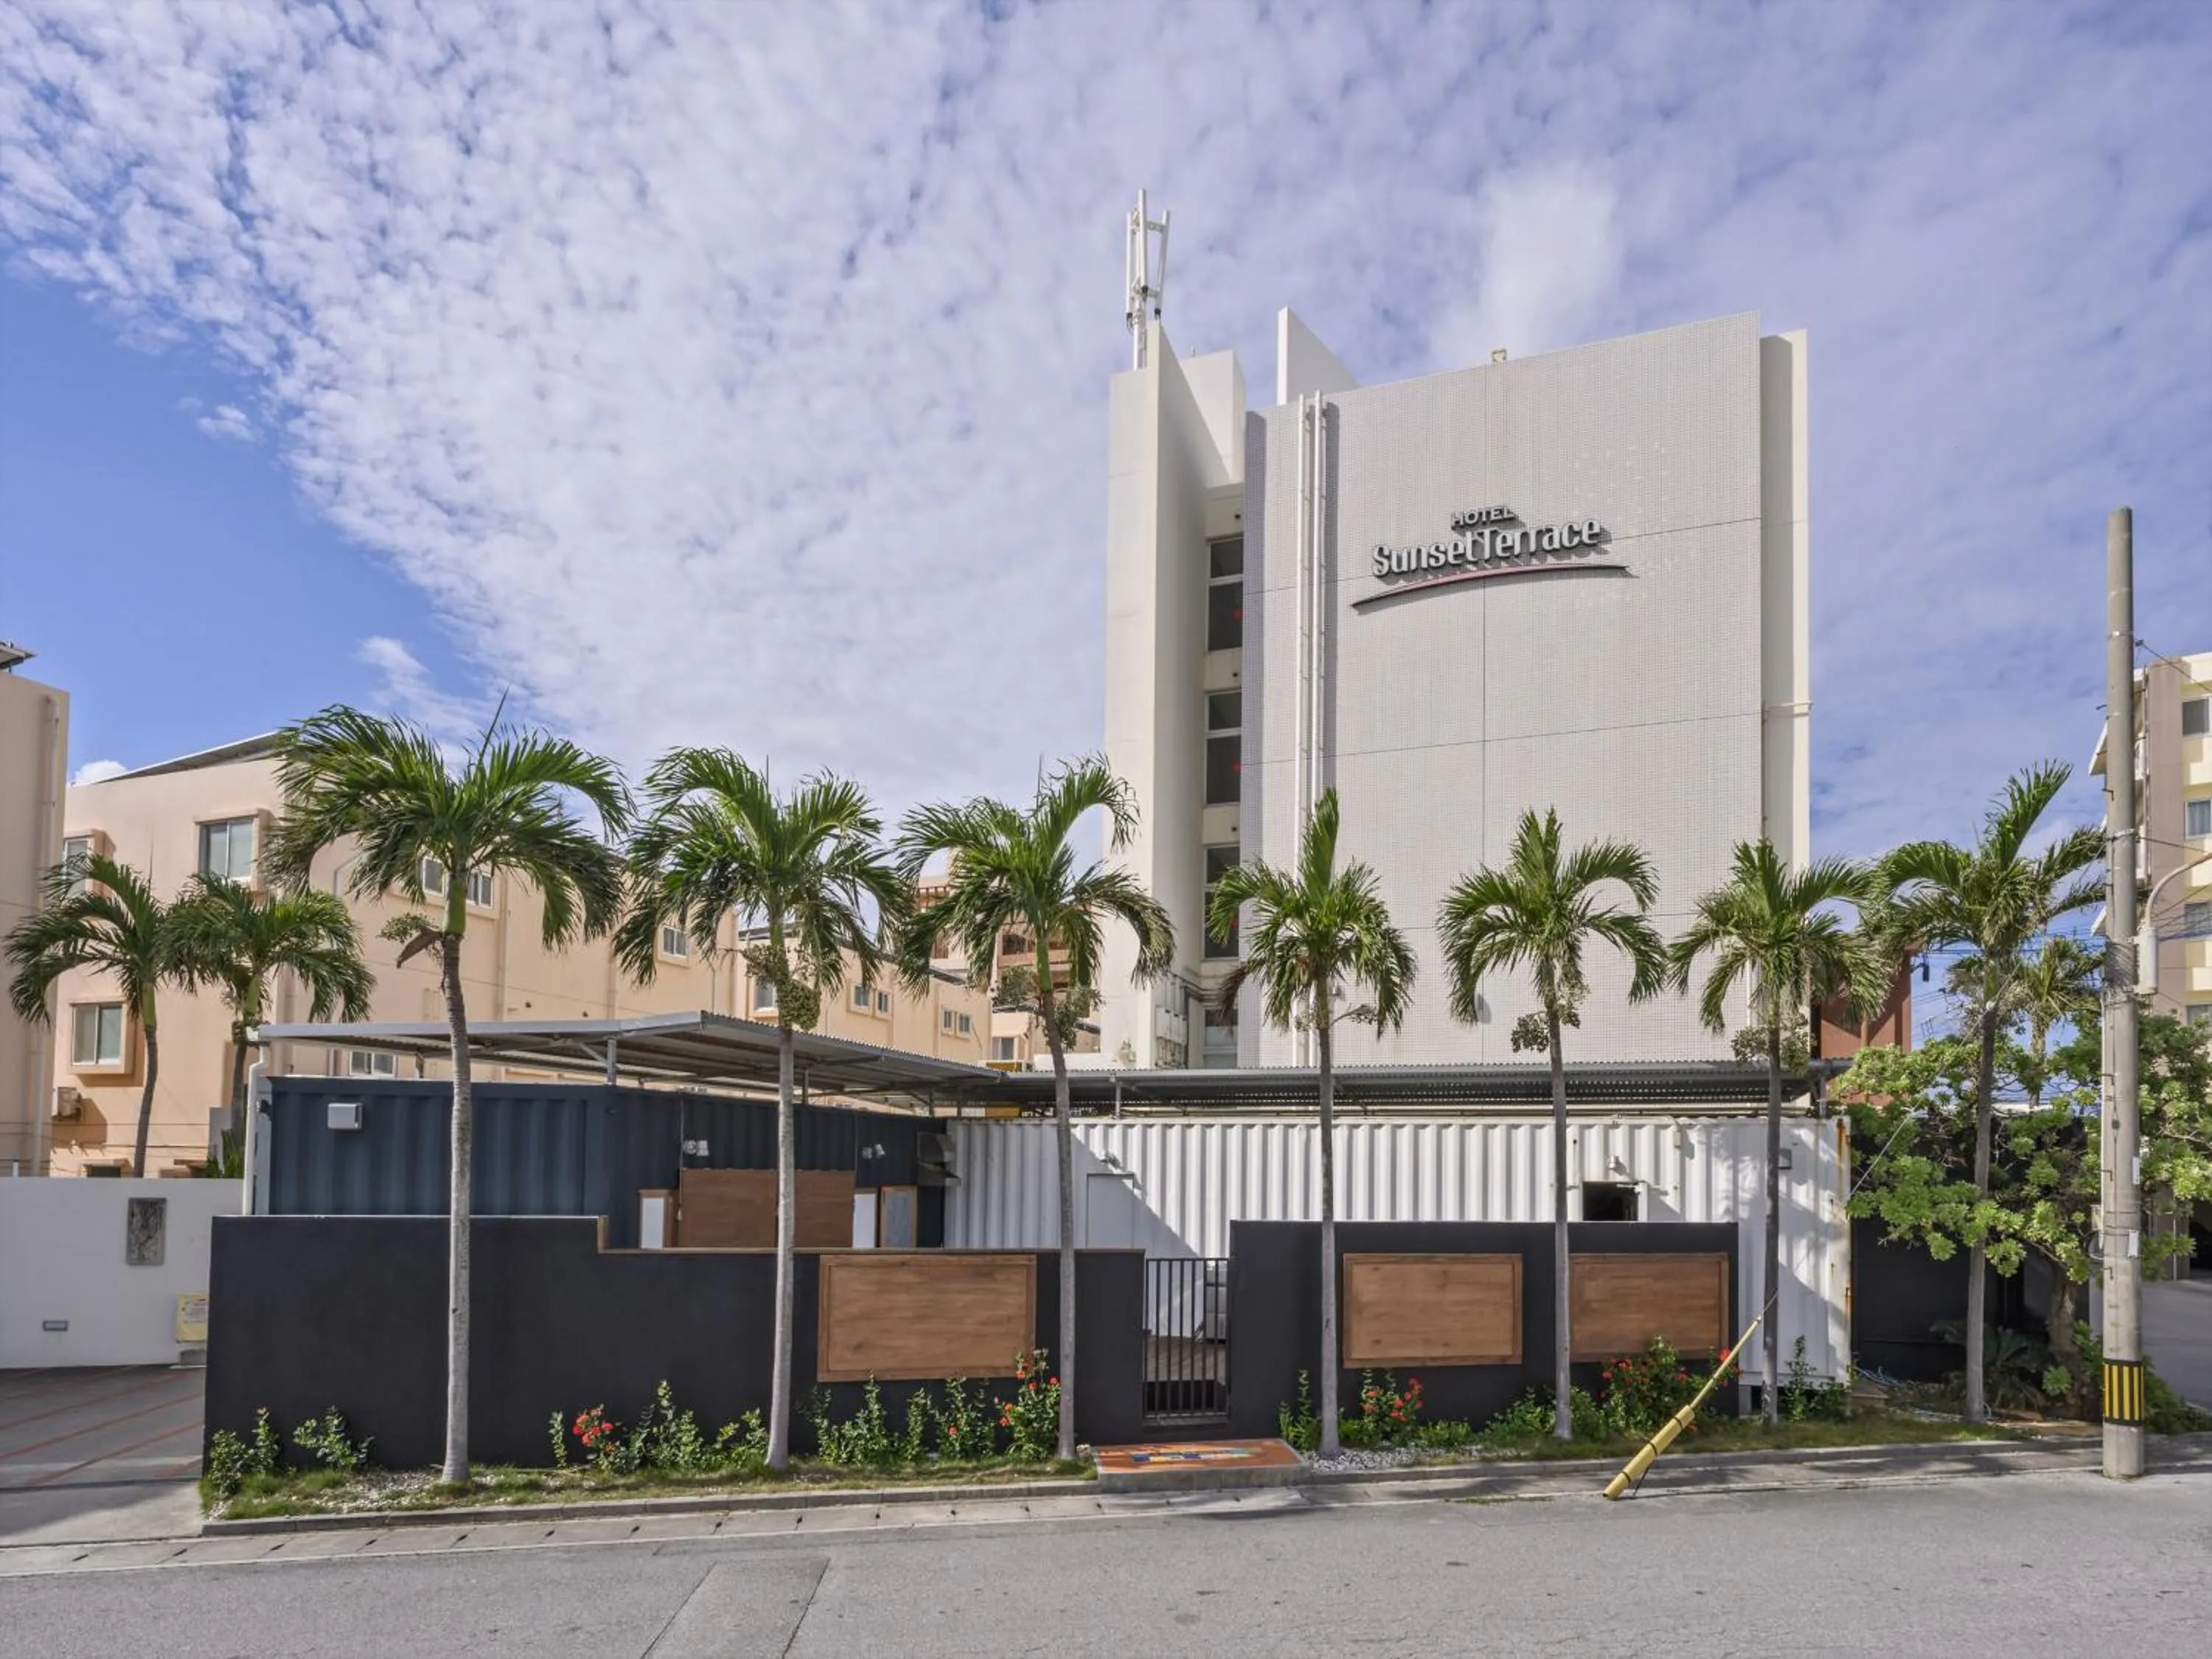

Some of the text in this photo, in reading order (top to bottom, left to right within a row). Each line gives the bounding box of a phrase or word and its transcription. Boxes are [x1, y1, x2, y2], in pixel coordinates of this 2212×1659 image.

[1452, 505, 1517, 527] HOTEL
[1372, 518, 1601, 577] Sunset Terrace
